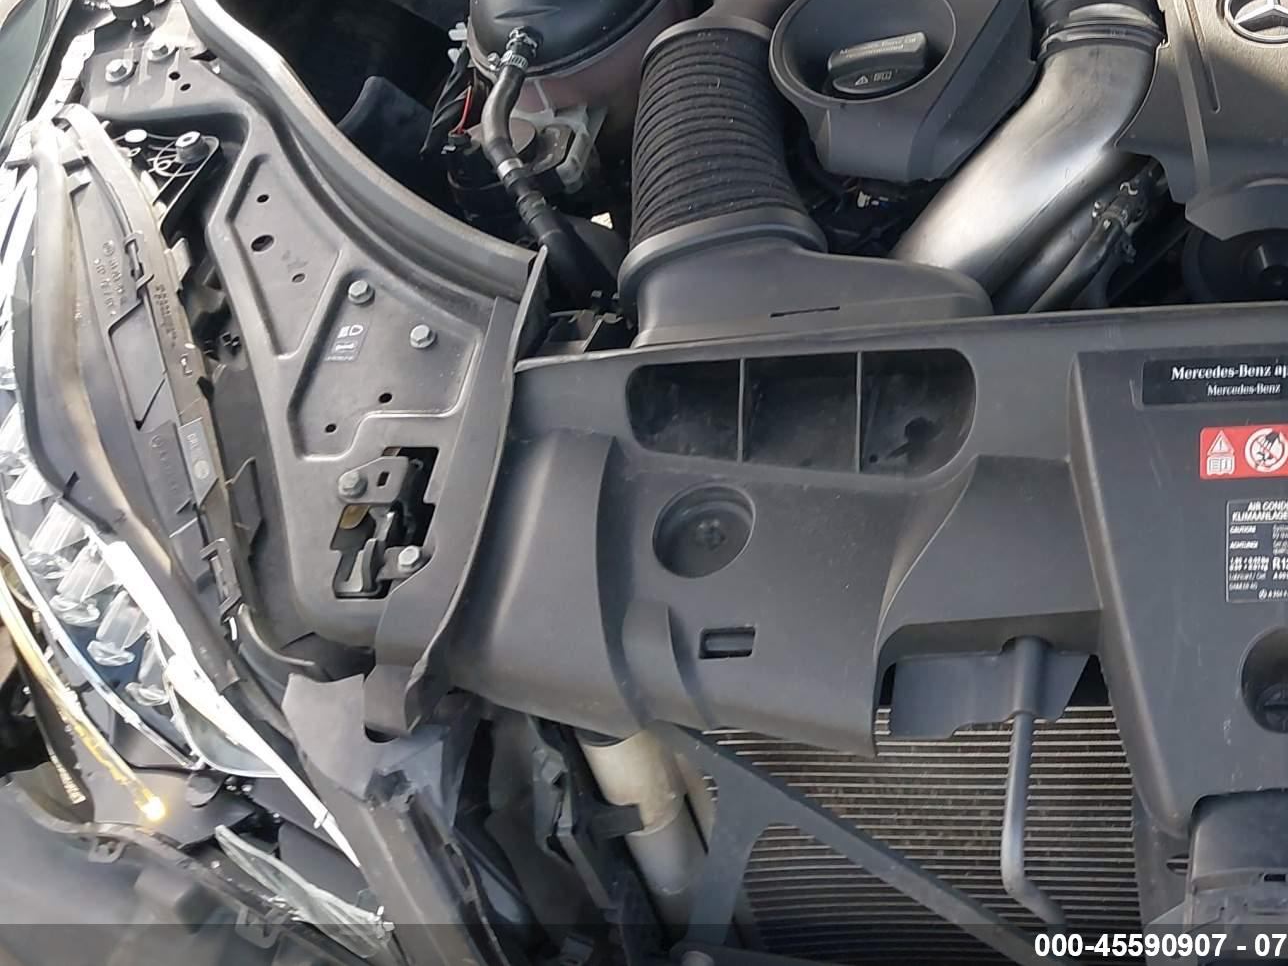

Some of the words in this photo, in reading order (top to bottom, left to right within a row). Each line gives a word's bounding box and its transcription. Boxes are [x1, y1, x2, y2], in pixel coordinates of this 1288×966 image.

[1171, 364, 1272, 381] Mercedes-Benz
[1206, 383, 1281, 396] Mercedes-Benz
[1247, 501, 1262, 512] AIR
